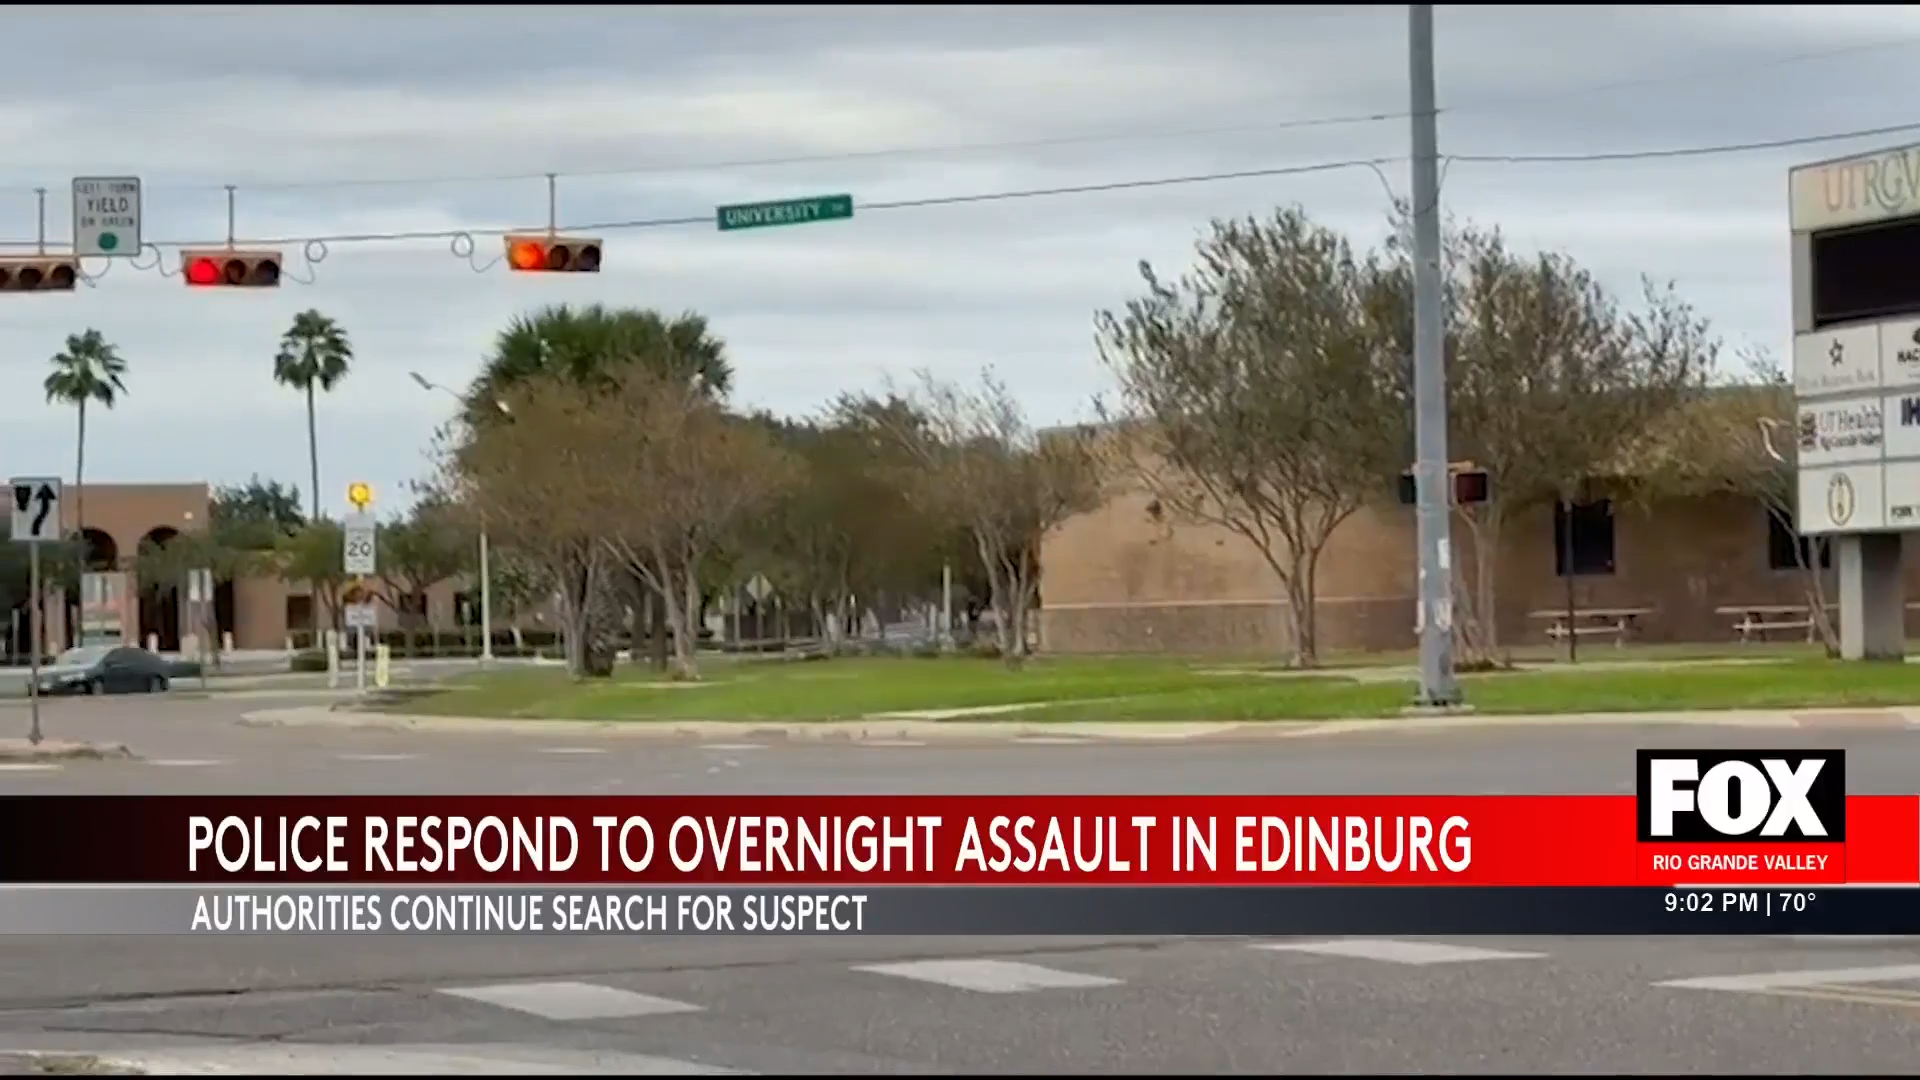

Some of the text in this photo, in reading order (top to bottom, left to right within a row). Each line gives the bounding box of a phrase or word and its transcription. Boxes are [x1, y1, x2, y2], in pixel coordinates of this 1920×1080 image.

[87, 196, 129, 213] YIELD
[725, 202, 822, 226] UNIVERSITY
[348, 541, 371, 557] 20
